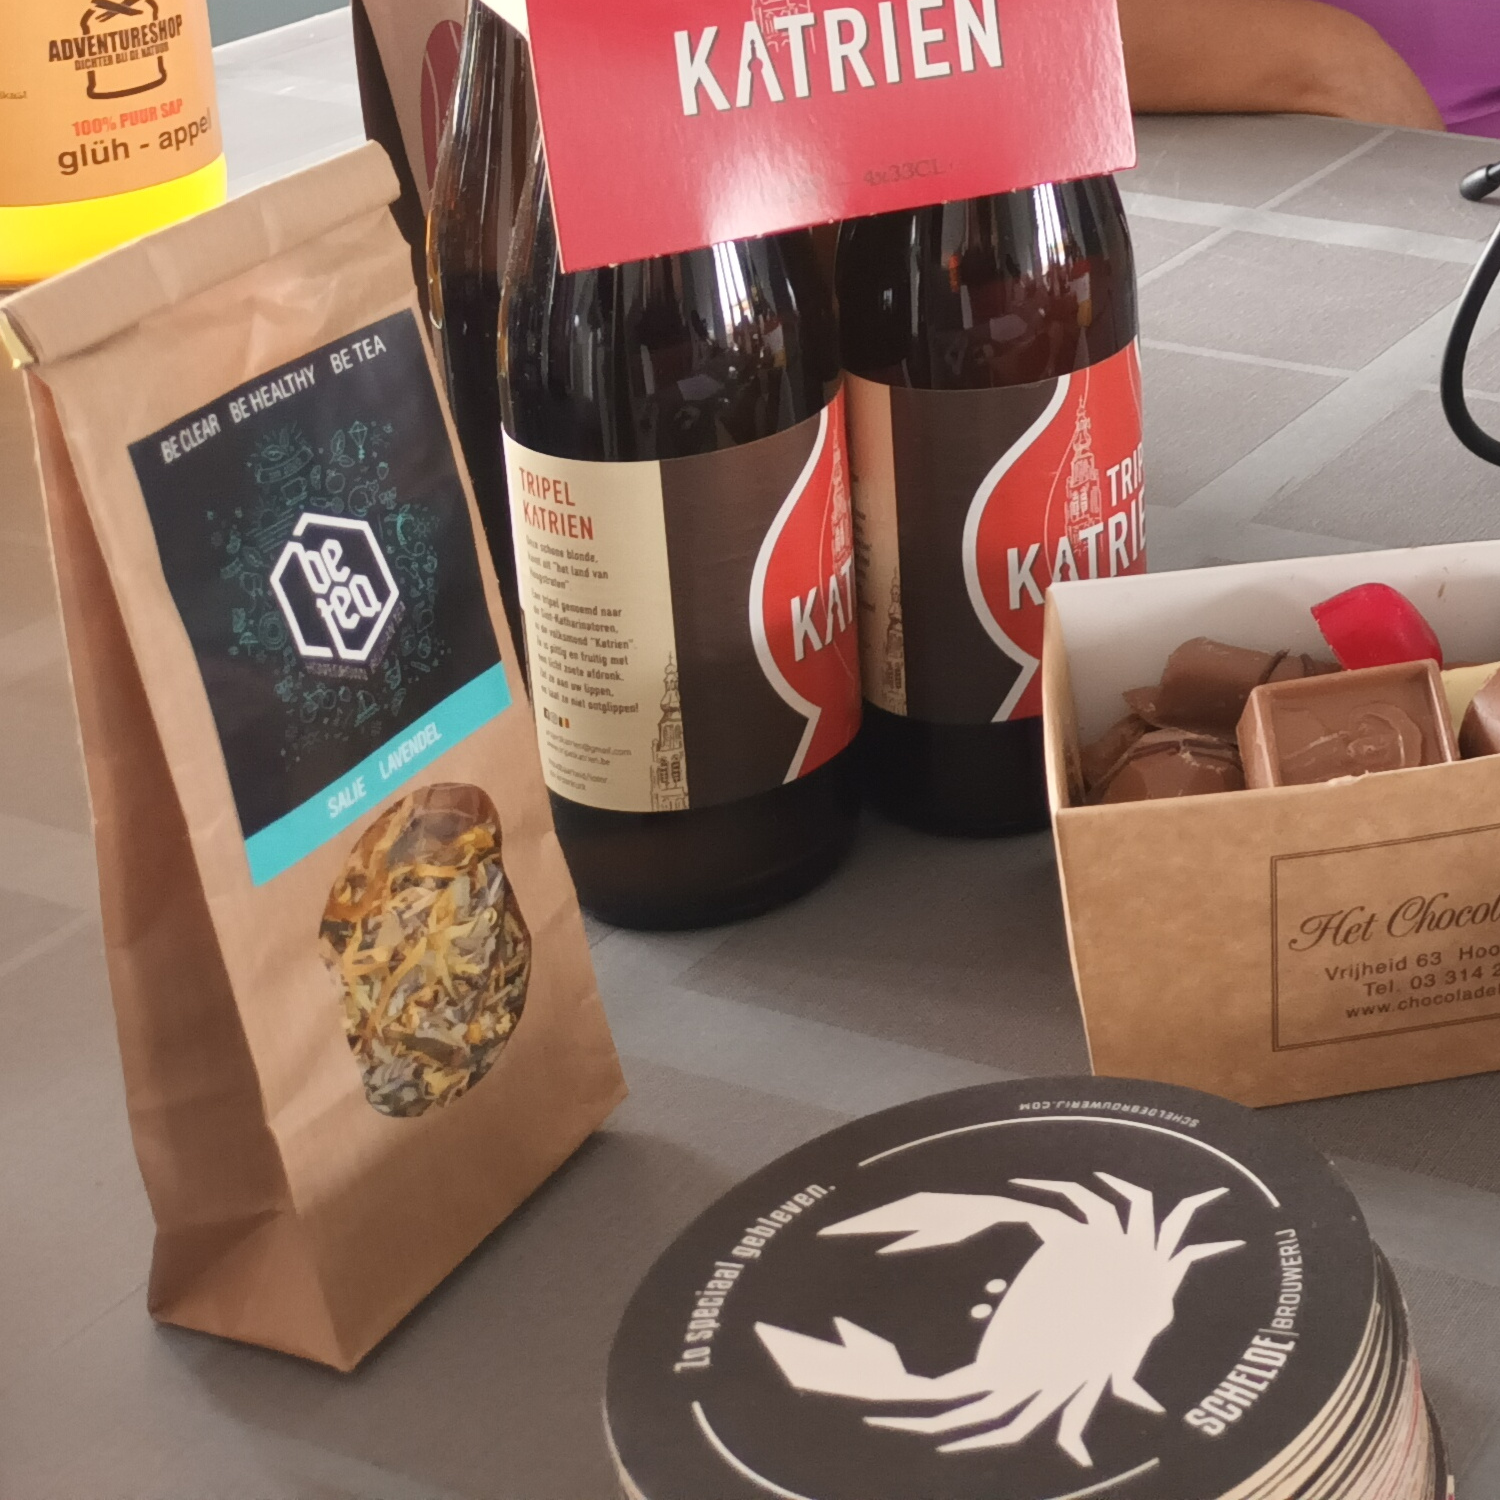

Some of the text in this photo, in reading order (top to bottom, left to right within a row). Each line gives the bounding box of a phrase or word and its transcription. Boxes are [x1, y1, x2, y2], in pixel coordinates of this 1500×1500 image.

[49, 14, 183, 62] ADVENTURESHOP
[72, 98, 183, 137] 100% PUUR SAP
[58, 138, 130, 176] glüh
[158, 107, 212, 151] appel
[160, 334, 387, 465] BE CLEAR BE HEALTHY BE TEA
[519, 467, 576, 507] TRIPEL
[523, 499, 594, 540] KATRIEN
[328, 722, 442, 819] SALIE LAVENDEL
[1288, 905, 1379, 951] Het
[1325, 956, 1408, 982] Vrijheid
[1416, 952, 1442, 968] 63
[1411, 974, 1437, 990] 03
[1445, 967, 1483, 984] 314
[1019, 1100, 1200, 1128] SCHELDEBROUWERIJ.COM
[684, 1261, 745, 1343] speciaal
[731, 1184, 836, 1259] gebleven.
[1184, 1228, 1303, 1436] SCHELDE BROUWERIJ
